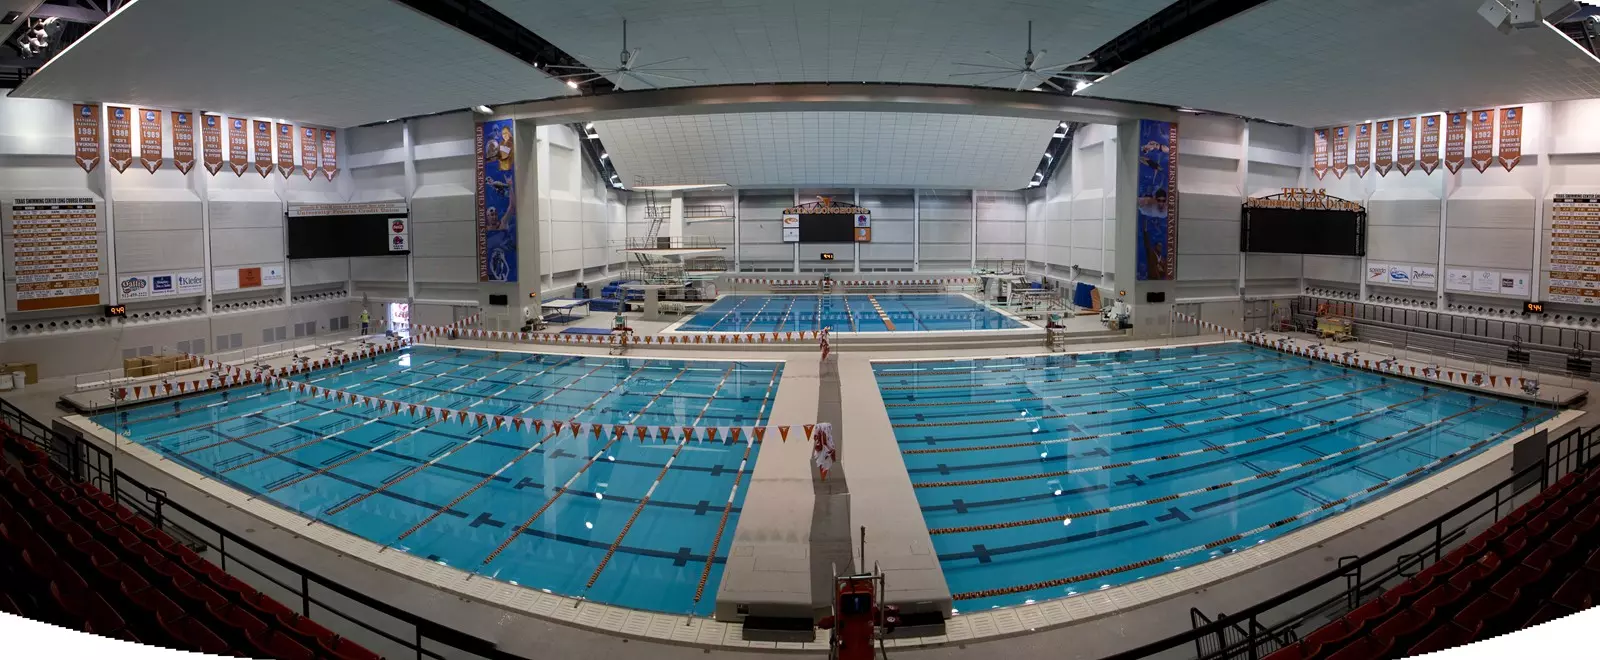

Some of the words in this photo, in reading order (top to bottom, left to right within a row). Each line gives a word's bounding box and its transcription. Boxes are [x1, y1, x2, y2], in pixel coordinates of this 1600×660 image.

[1281, 188, 1326, 199] TEXAS
[1168, 195, 1175, 205] OF
[1248, 197, 1301, 209] Swimming
[1304, 200, 1322, 209] and
[1326, 199, 1360, 212] Diving
[183, 277, 202, 285] Kiefer
